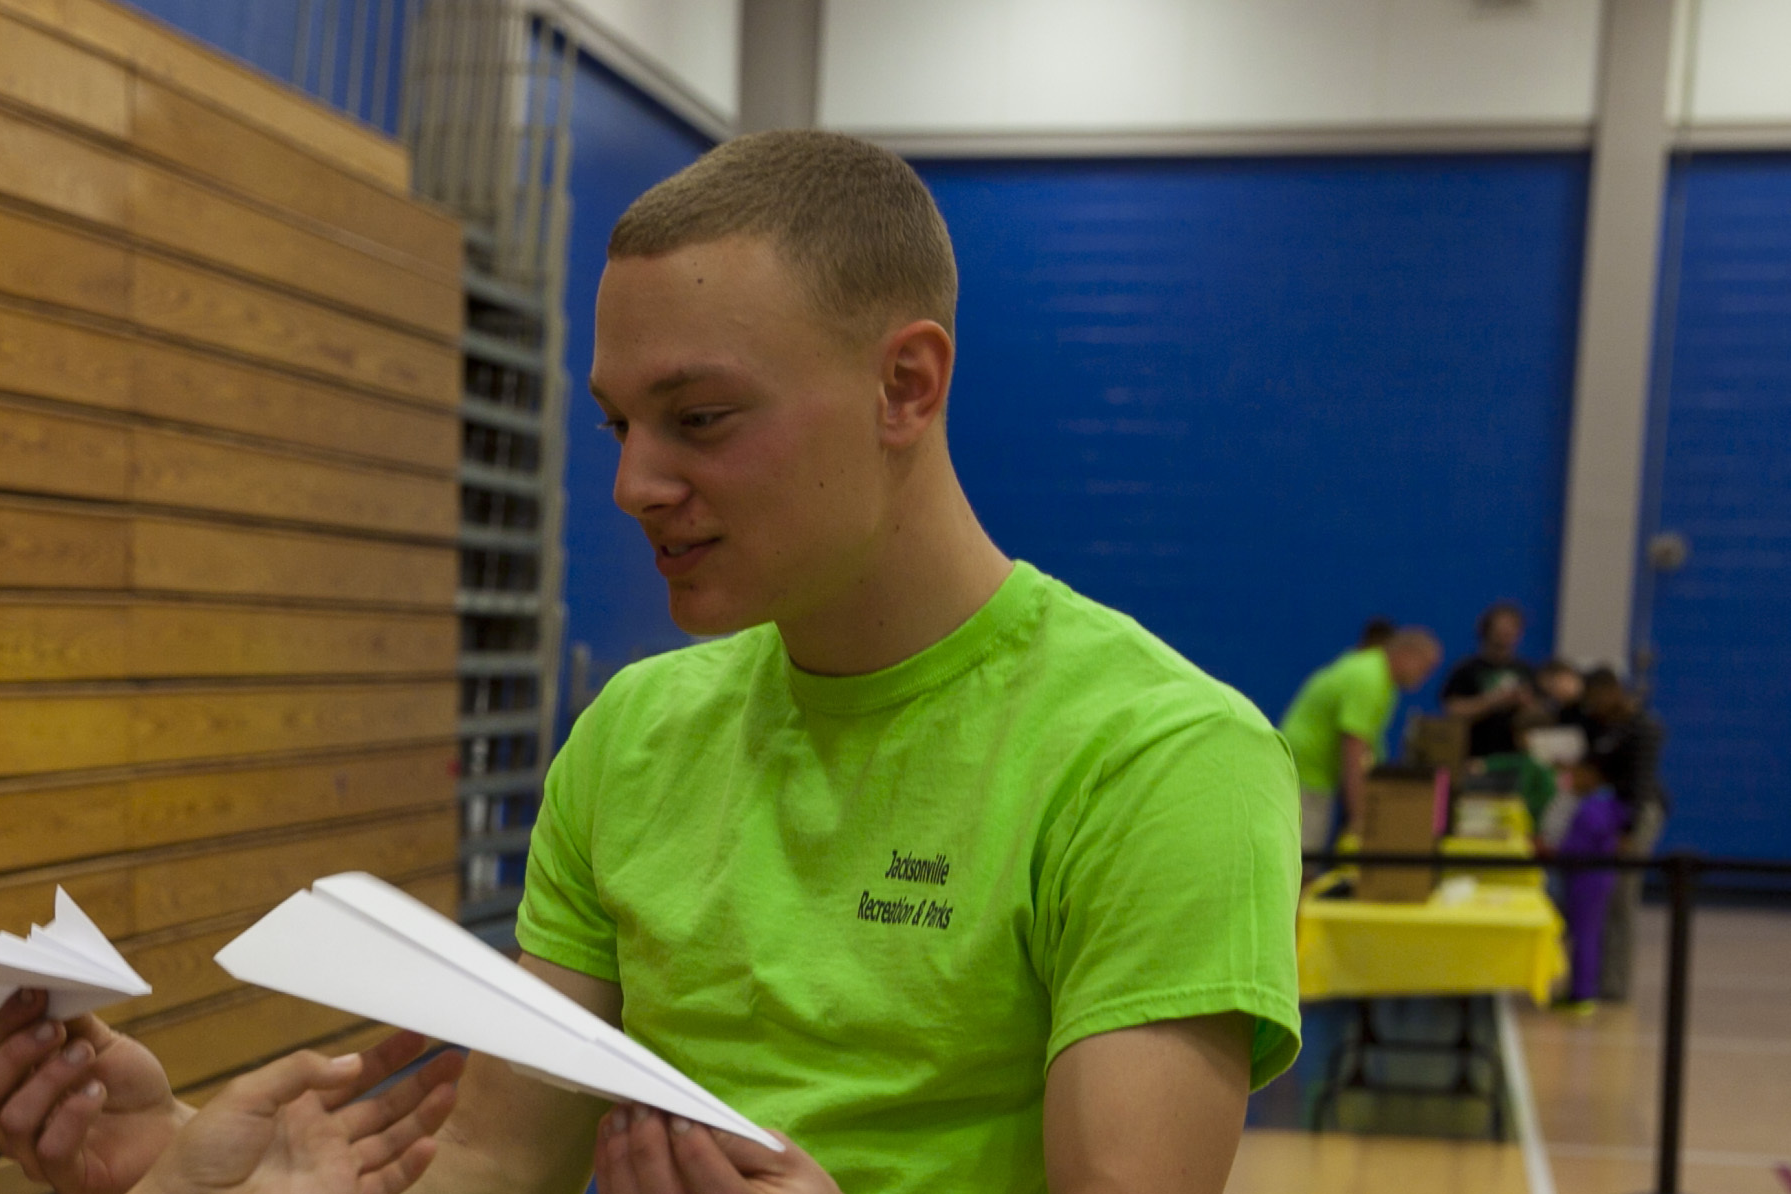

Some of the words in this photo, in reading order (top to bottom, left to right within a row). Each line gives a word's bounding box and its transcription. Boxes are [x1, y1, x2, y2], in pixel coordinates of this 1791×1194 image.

[885, 849, 950, 885] Jacksonville
[857, 890, 915, 925] Recreation
[911, 899, 927, 926] &
[921, 898, 954, 930] Parks
